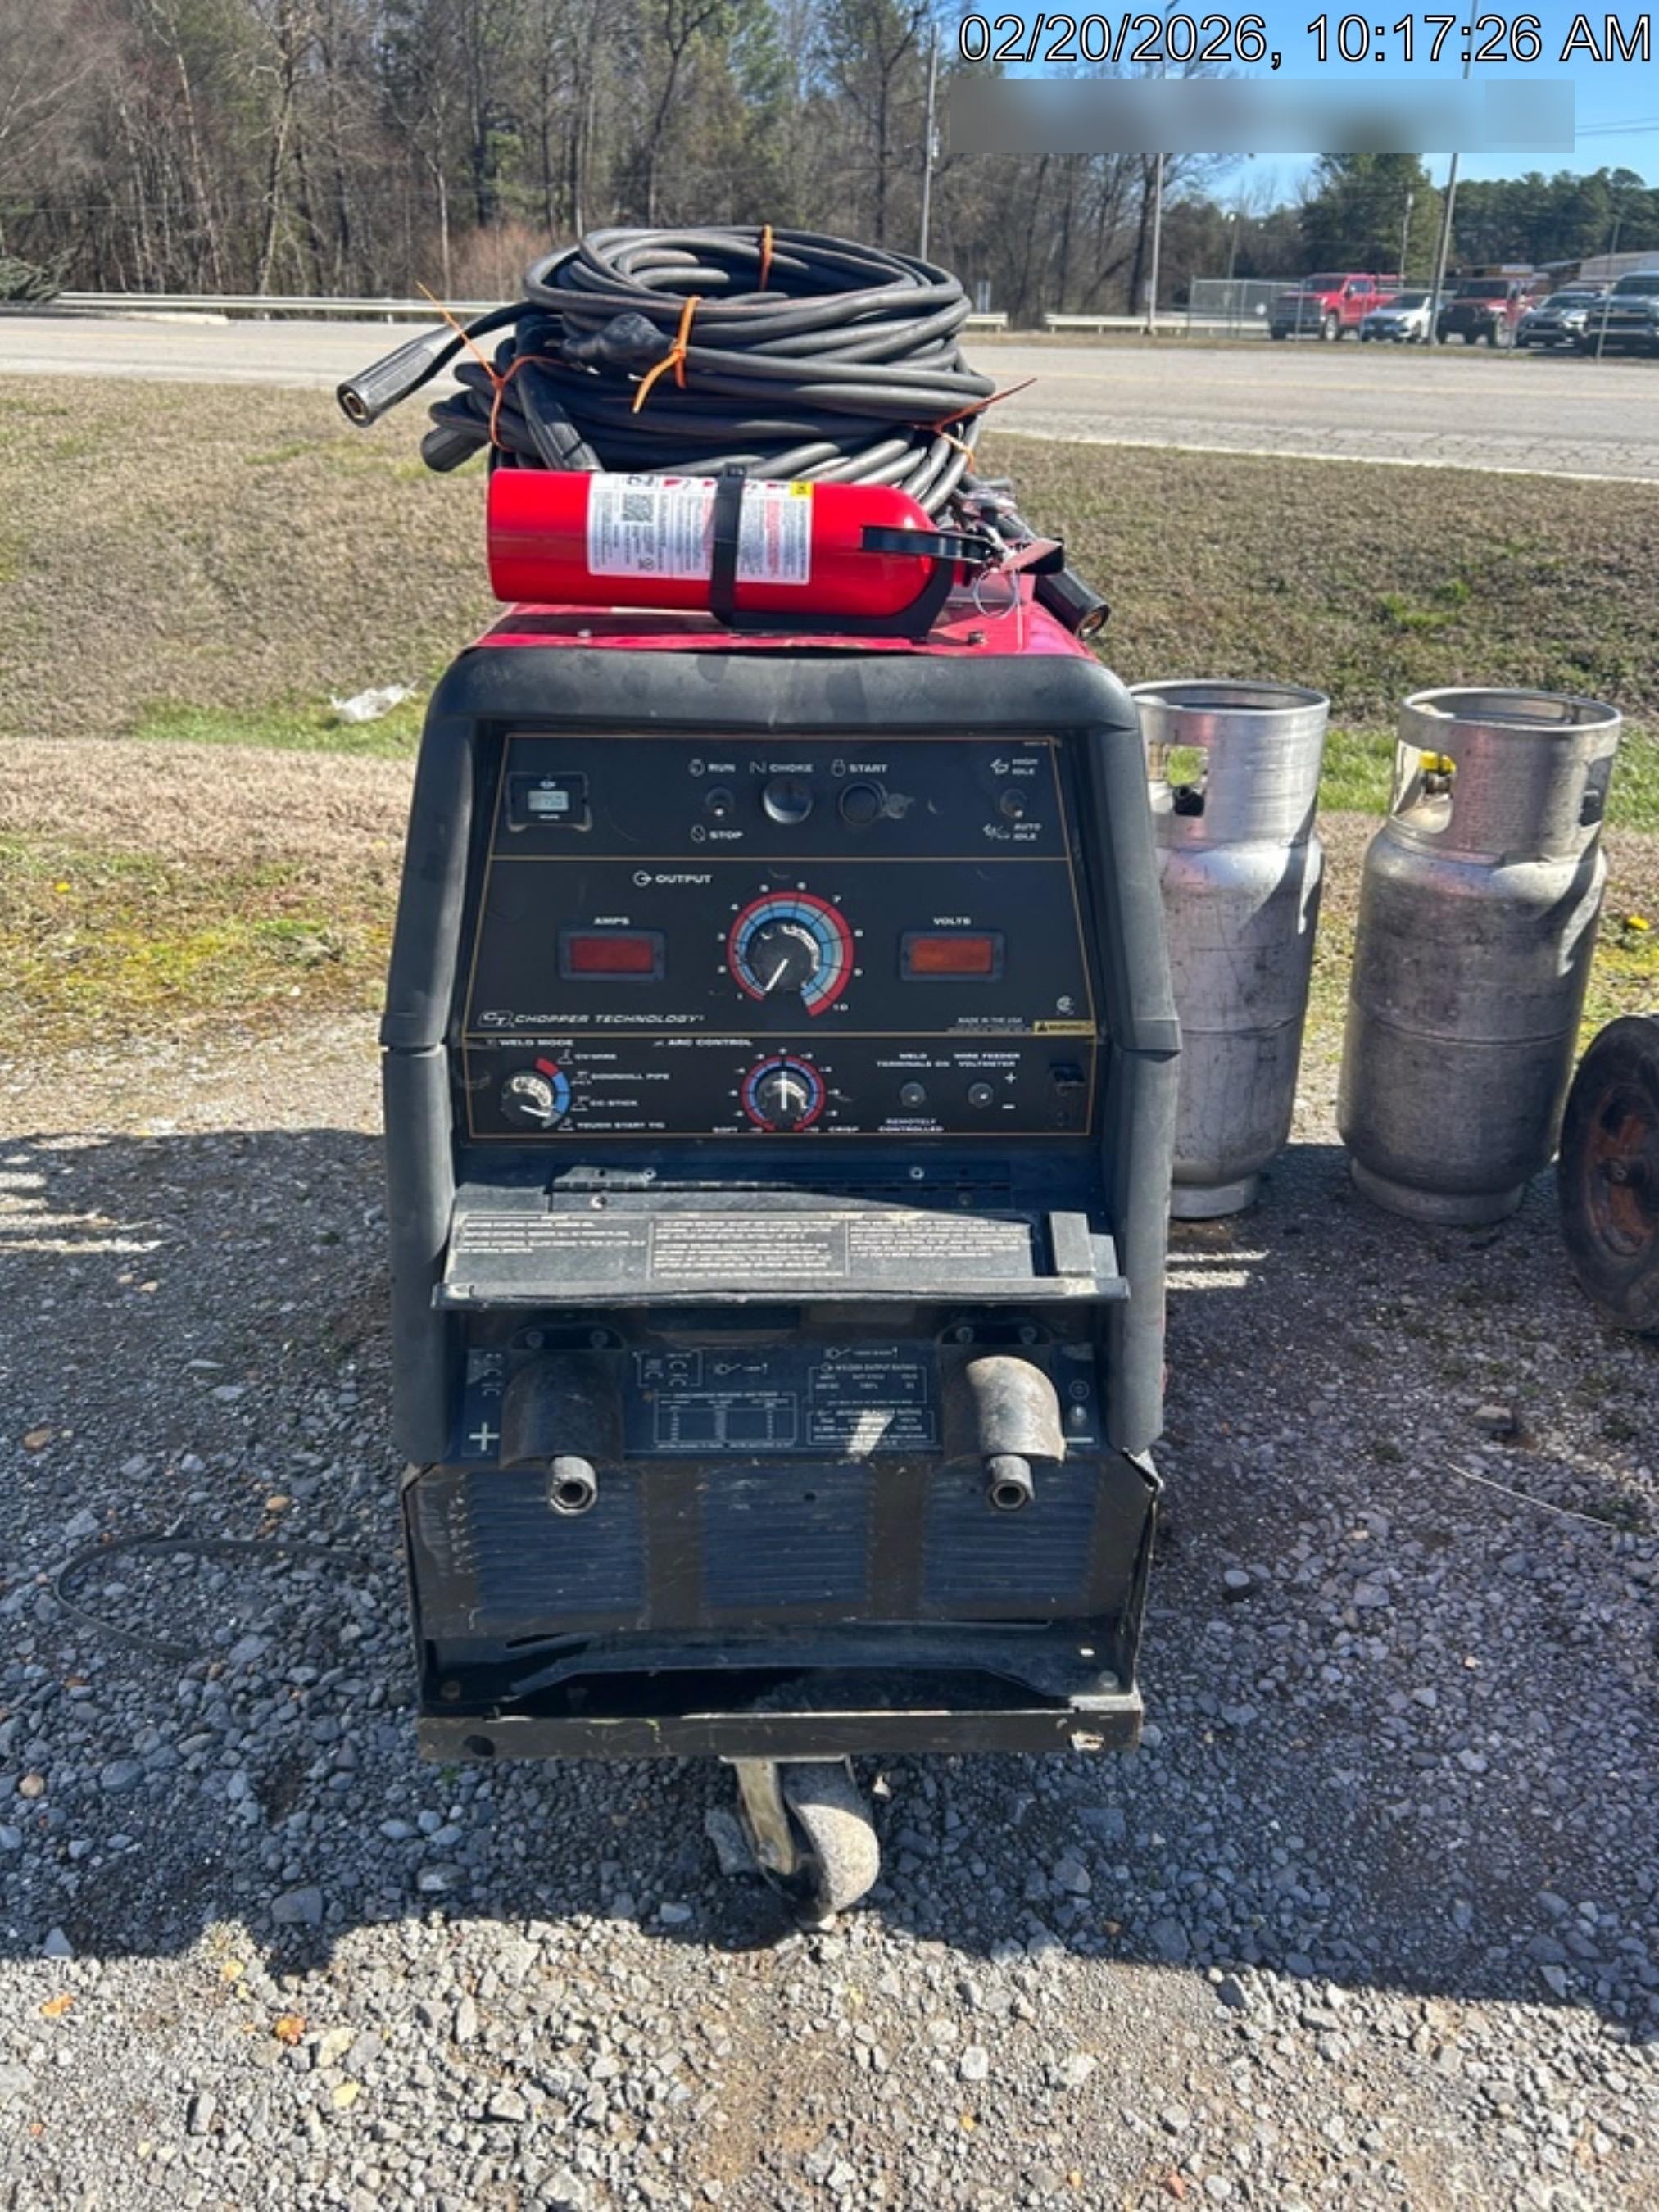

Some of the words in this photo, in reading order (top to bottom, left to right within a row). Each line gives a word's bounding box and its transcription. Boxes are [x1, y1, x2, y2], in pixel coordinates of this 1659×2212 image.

[708, 764, 736, 773] RUN
[768, 764, 813, 773] CHOKE
[849, 764, 888, 773] START
[709, 830, 743, 840] STOP
[655, 874, 712, 884] OUTPUT
[594, 917, 629, 926] AMPS
[933, 916, 972, 926] VOLTS
[514, 1014, 589, 1023] CHOPPER
[696, 1038, 752, 1047] CONTROL
